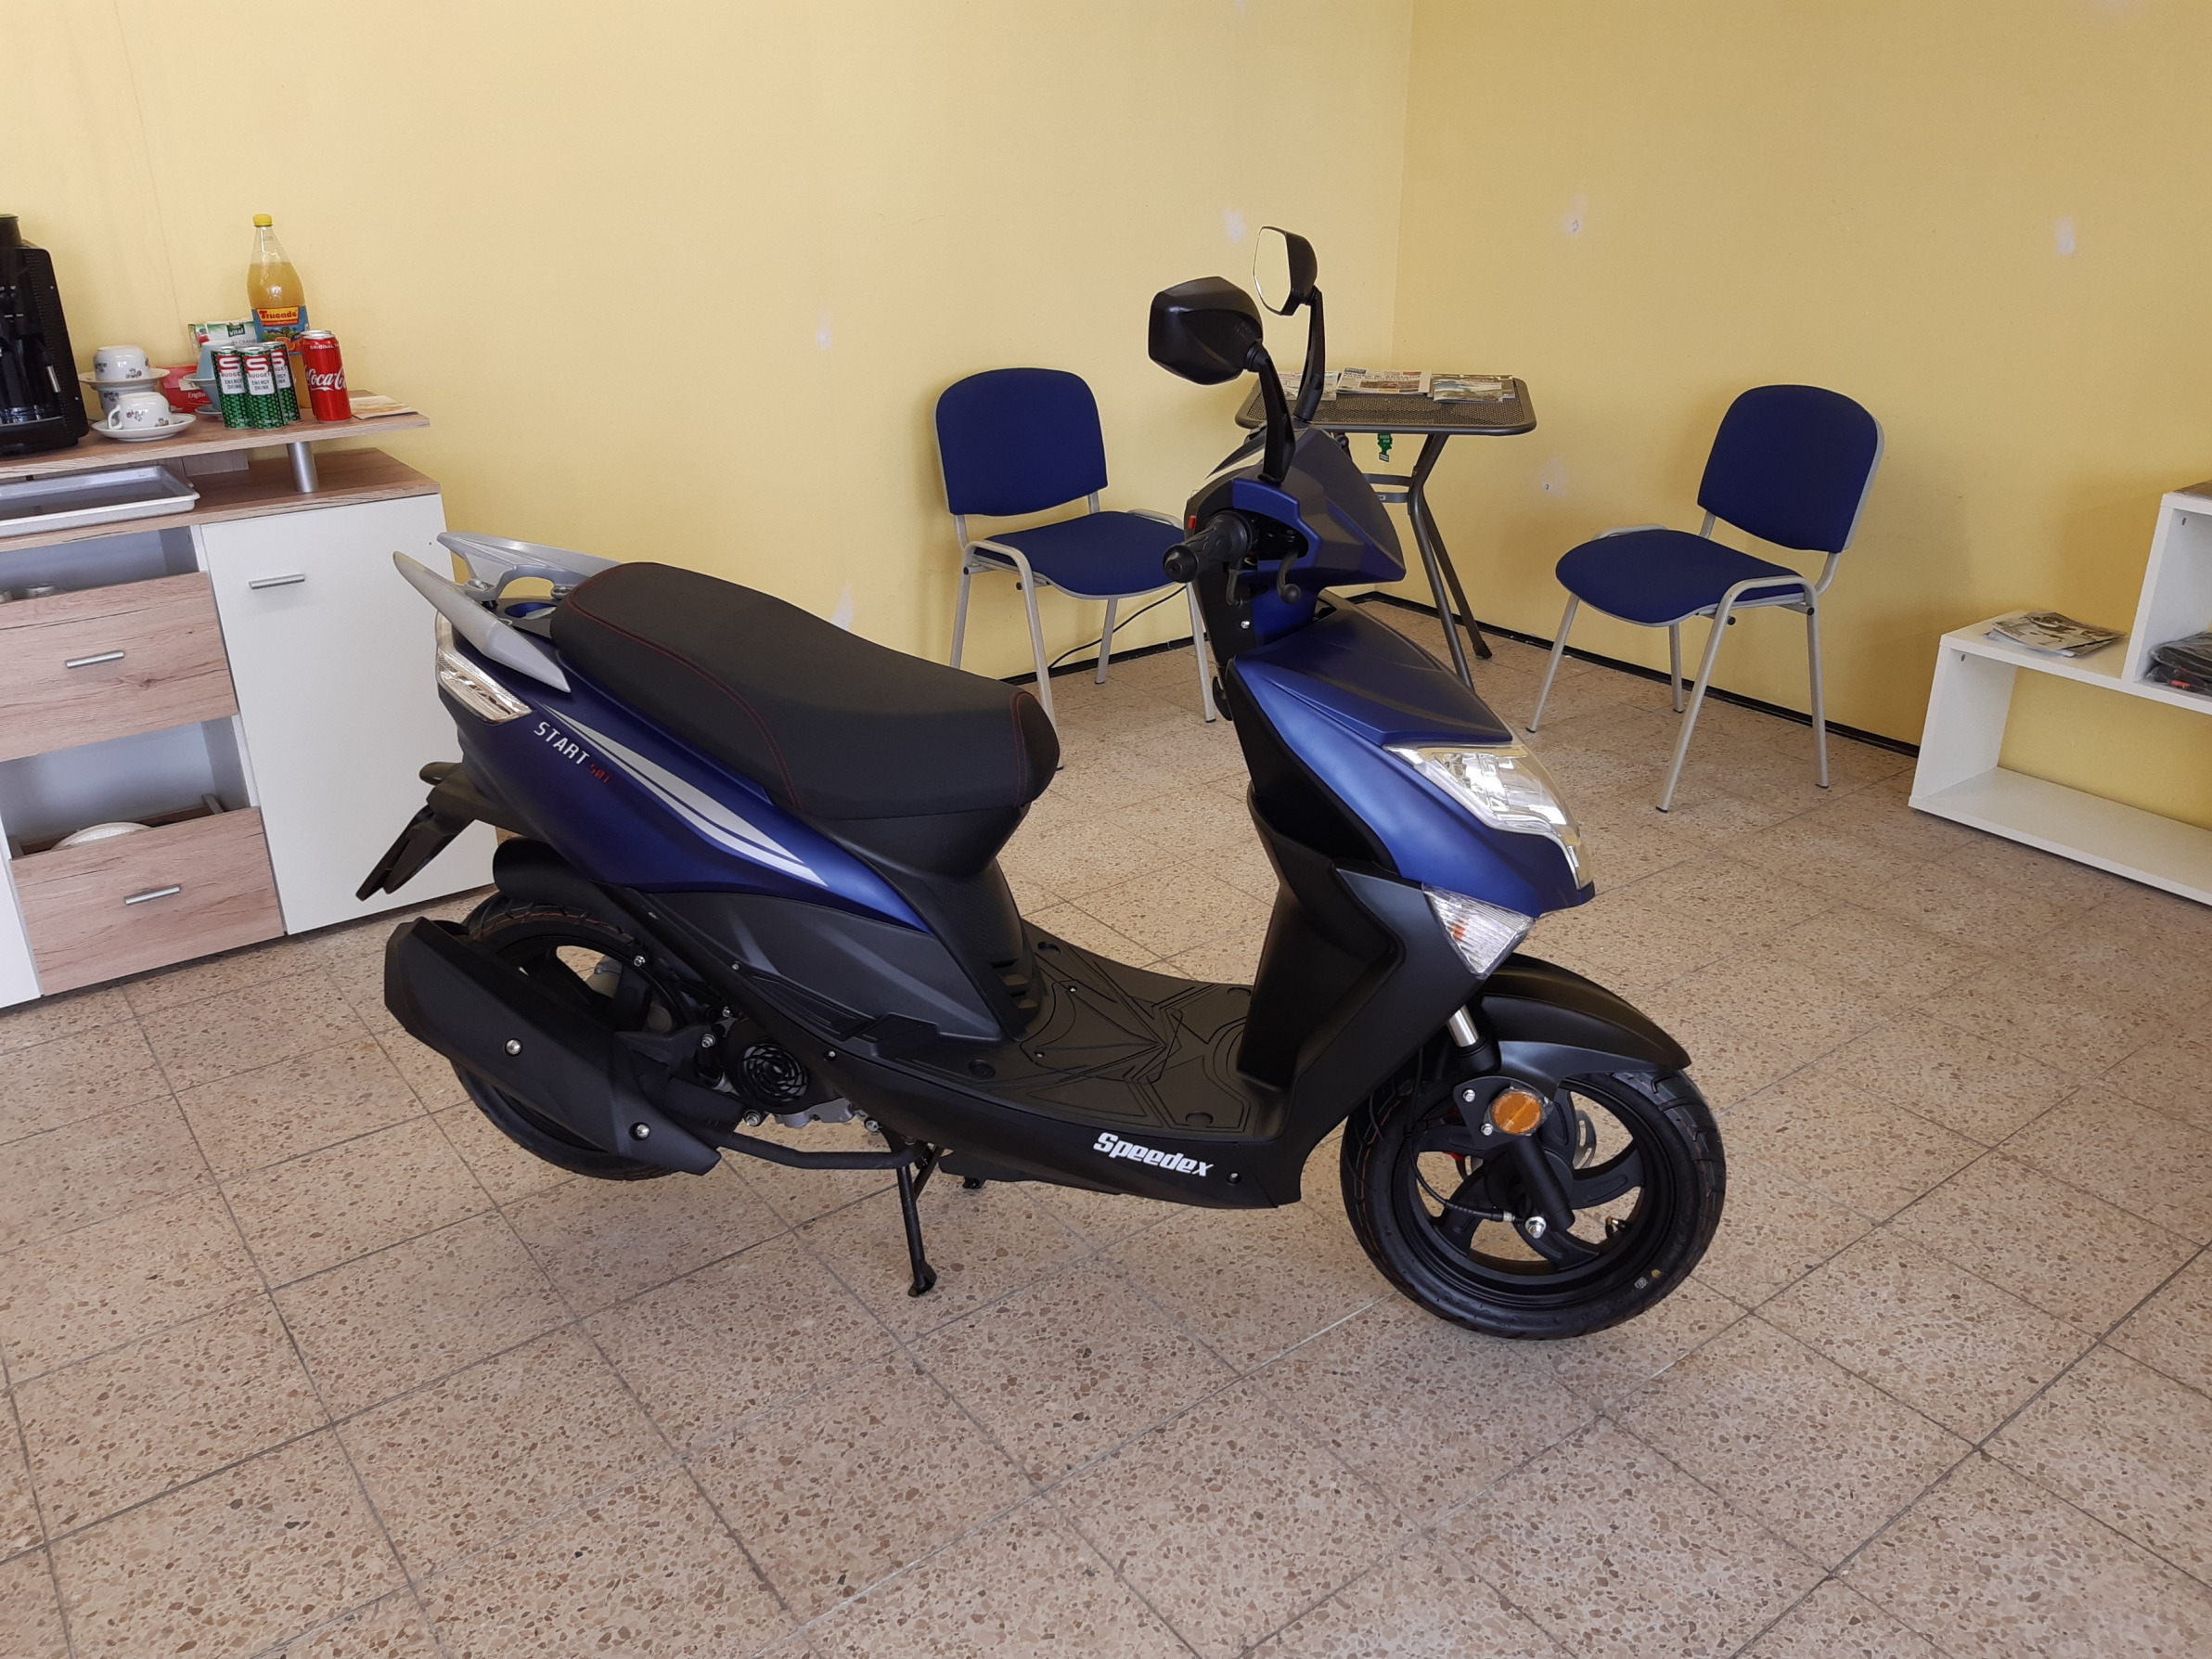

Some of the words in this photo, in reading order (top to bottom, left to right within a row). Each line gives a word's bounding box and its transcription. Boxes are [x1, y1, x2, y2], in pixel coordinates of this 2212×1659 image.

[259, 310, 297, 319] Trucade
[533, 721, 591, 765] START
[1093, 1132, 1215, 1177] Speedex
